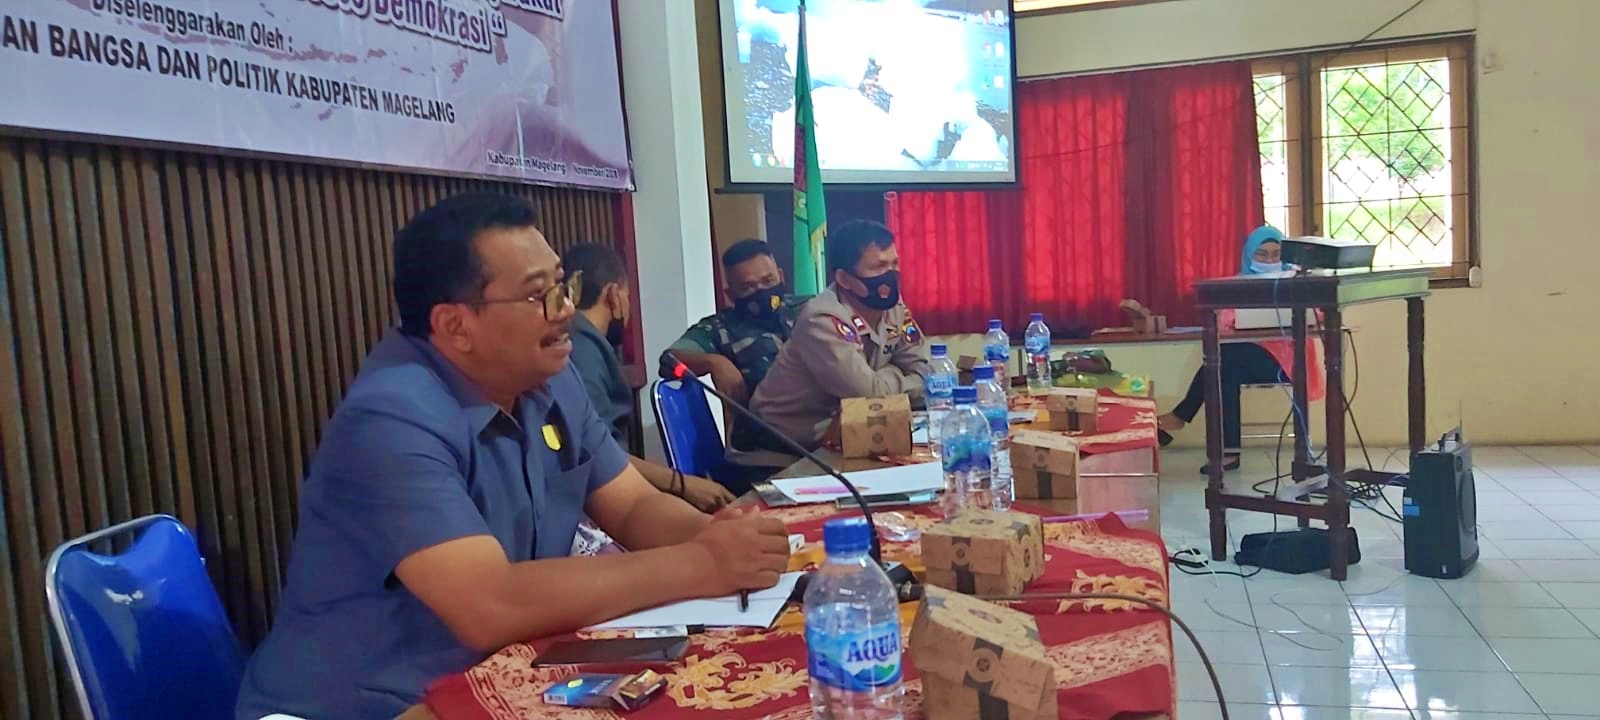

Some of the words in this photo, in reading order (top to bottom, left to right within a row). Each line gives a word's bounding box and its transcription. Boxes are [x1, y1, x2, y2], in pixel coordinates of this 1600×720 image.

[250, 21, 284, 49] Oleh
[2, 15, 39, 54] AN
[48, 24, 151, 72] BANGSA
[157, 45, 201, 80] DAN
[207, 55, 282, 95] POLITIK
[286, 70, 378, 112] KABUPATEN
[382, 91, 456, 124] MAGELANG
[531, 158, 566, 175] Magelang
[847, 632, 898, 662] AQUA
